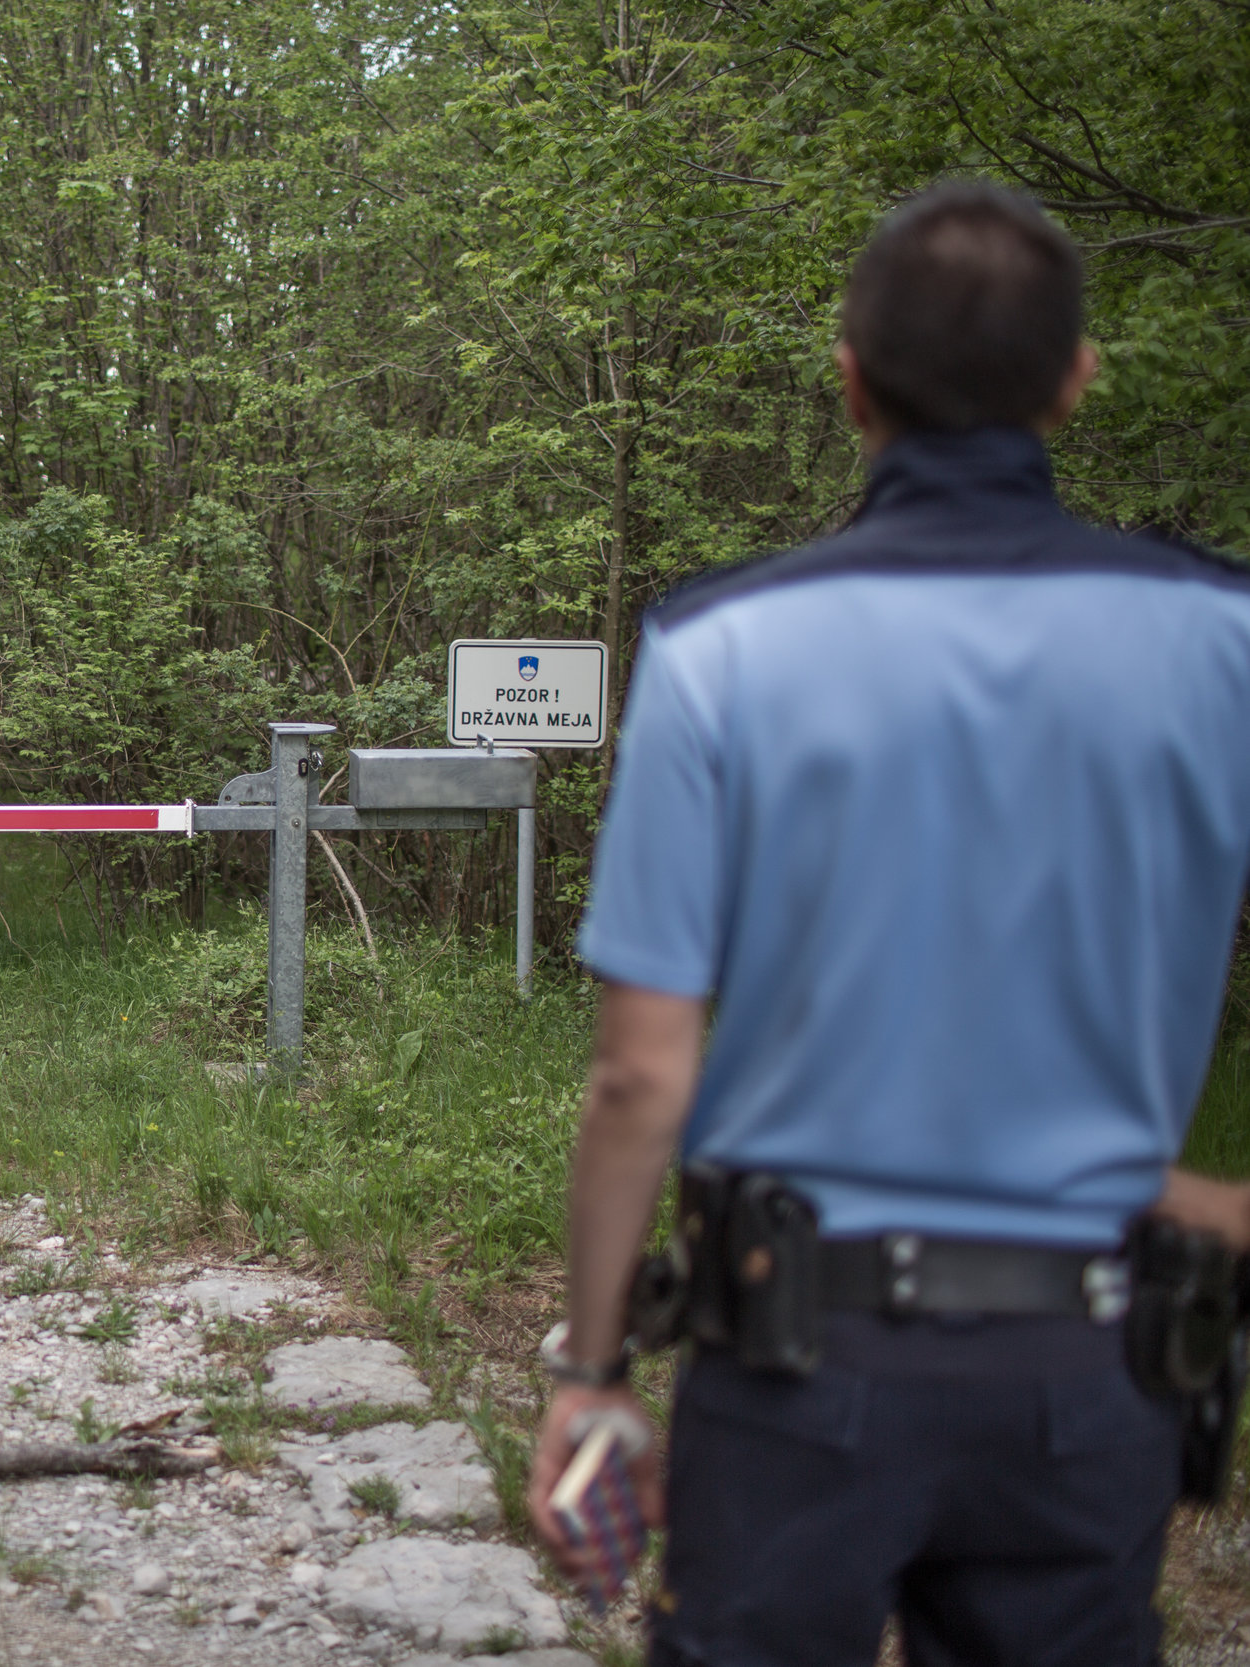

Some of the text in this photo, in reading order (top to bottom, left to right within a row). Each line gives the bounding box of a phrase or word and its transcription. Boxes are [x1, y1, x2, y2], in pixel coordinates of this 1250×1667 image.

[495, 688, 549, 703] POZOR
[461, 709, 592, 727] DRŽAVNA MEJA
